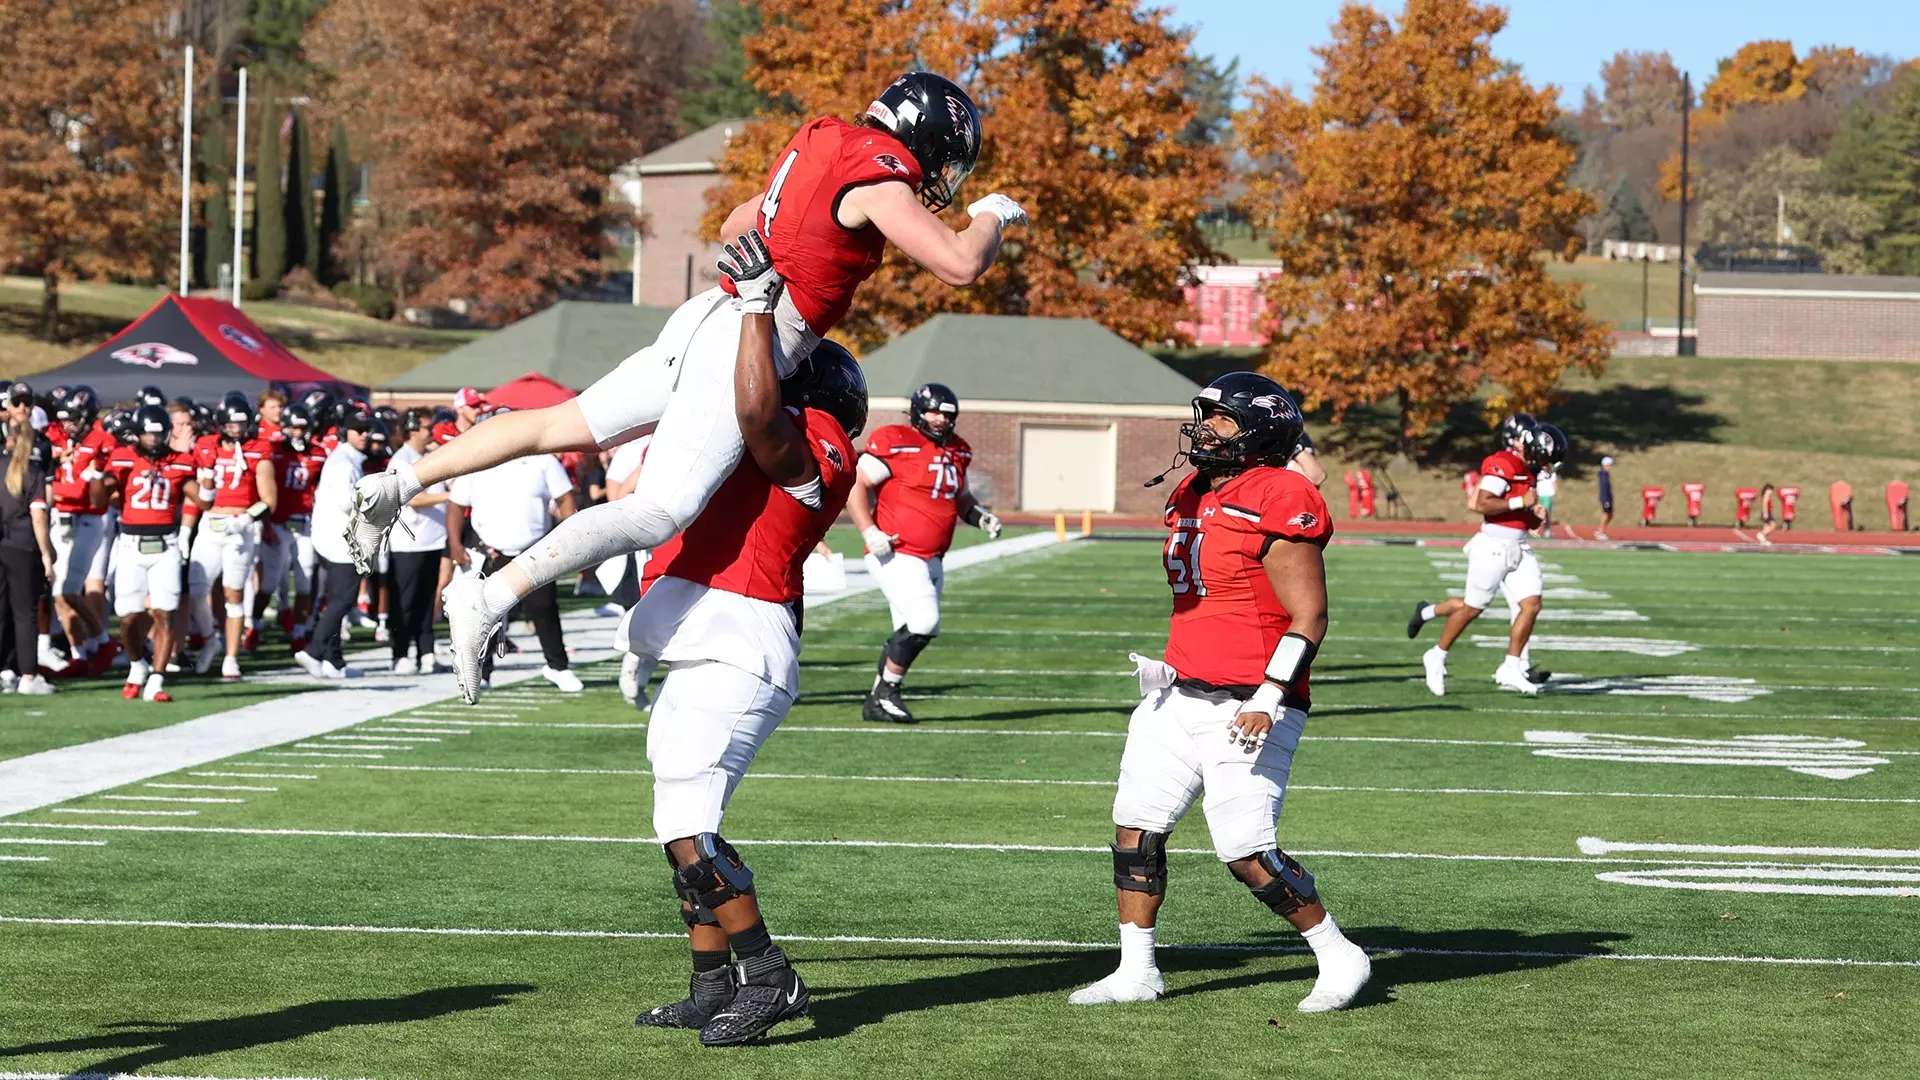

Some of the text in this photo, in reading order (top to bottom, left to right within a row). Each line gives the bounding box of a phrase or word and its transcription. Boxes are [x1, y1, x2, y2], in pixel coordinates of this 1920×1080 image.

[760, 148, 798, 238] 4
[131, 476, 170, 510] 20
[928, 463, 959, 499] 79
[1167, 532, 1207, 597] 51
